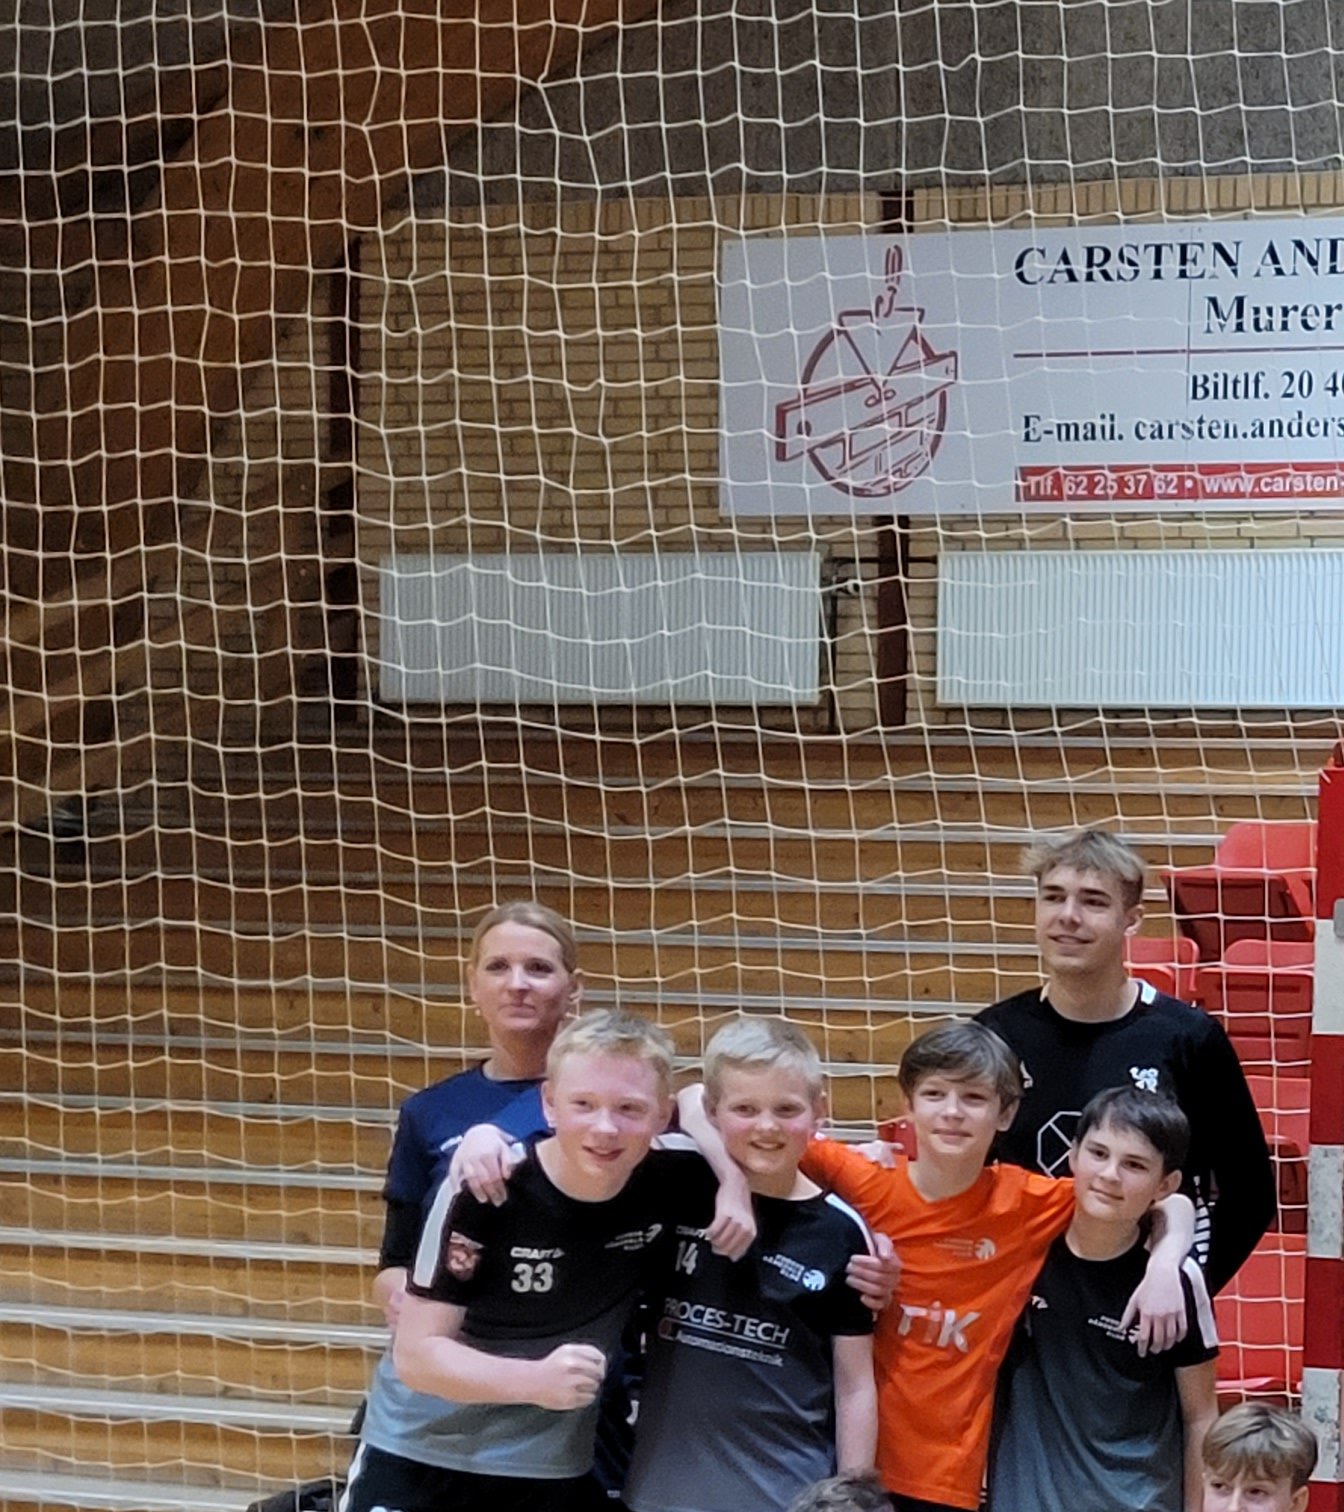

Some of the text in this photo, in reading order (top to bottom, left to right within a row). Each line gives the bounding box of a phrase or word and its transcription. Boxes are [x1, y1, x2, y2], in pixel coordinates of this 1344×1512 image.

[1013, 240, 1243, 285] CARSTEN
[1191, 371, 1270, 401] Biltlf.
[1281, 369, 1314, 399] 20
[1022, 413, 1125, 442] E-mail.
[1026, 475, 1058, 496] Tlf.
[1065, 476, 1088, 495] 62
[1094, 475, 1117, 494] 25
[1124, 475, 1147, 494] 37
[1154, 475, 1178, 494] 62
[510, 1262, 554, 1293] 33
